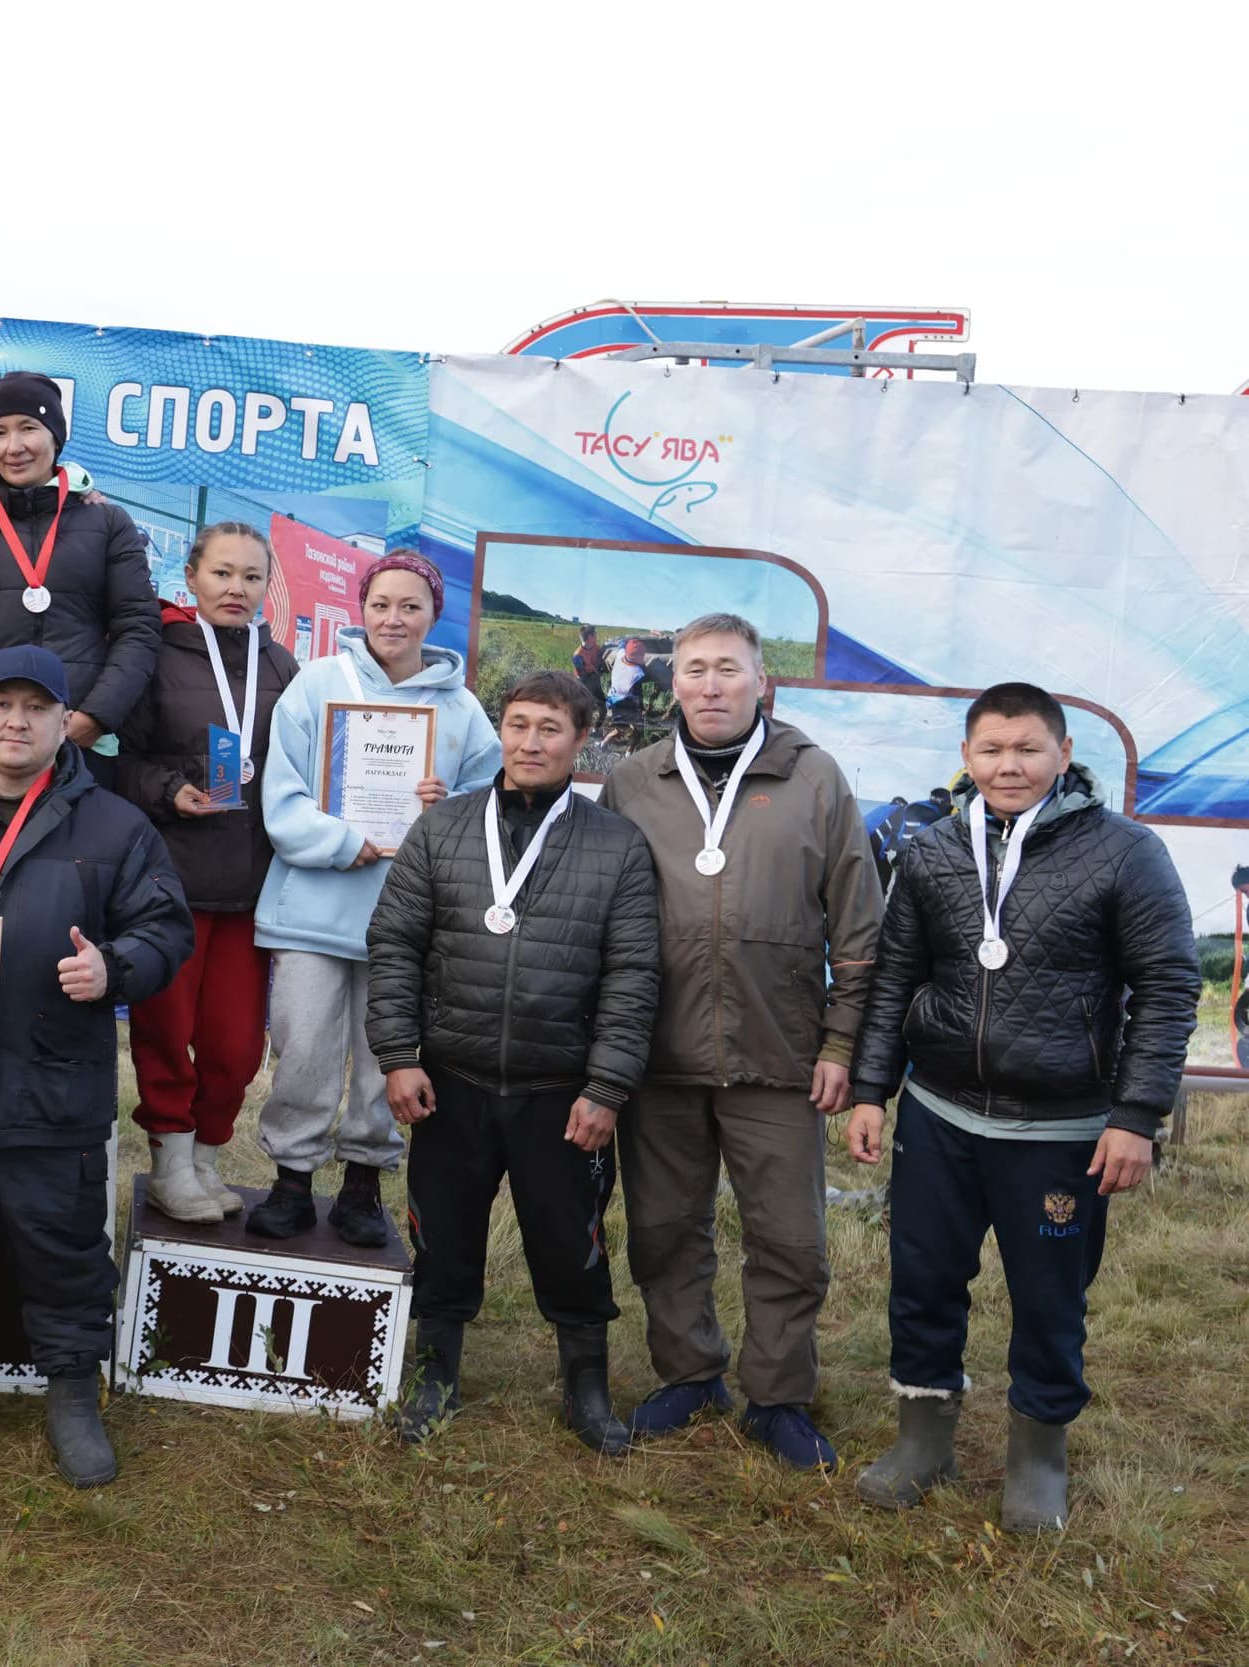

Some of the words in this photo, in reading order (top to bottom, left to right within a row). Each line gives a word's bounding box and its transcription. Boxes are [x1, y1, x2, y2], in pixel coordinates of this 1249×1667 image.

[105, 381, 381, 467] СПОРТА
[363, 742, 415, 756] ГРАМОТА
[1038, 1224, 1081, 1238] RUS
[200, 1286, 323, 1381] III
